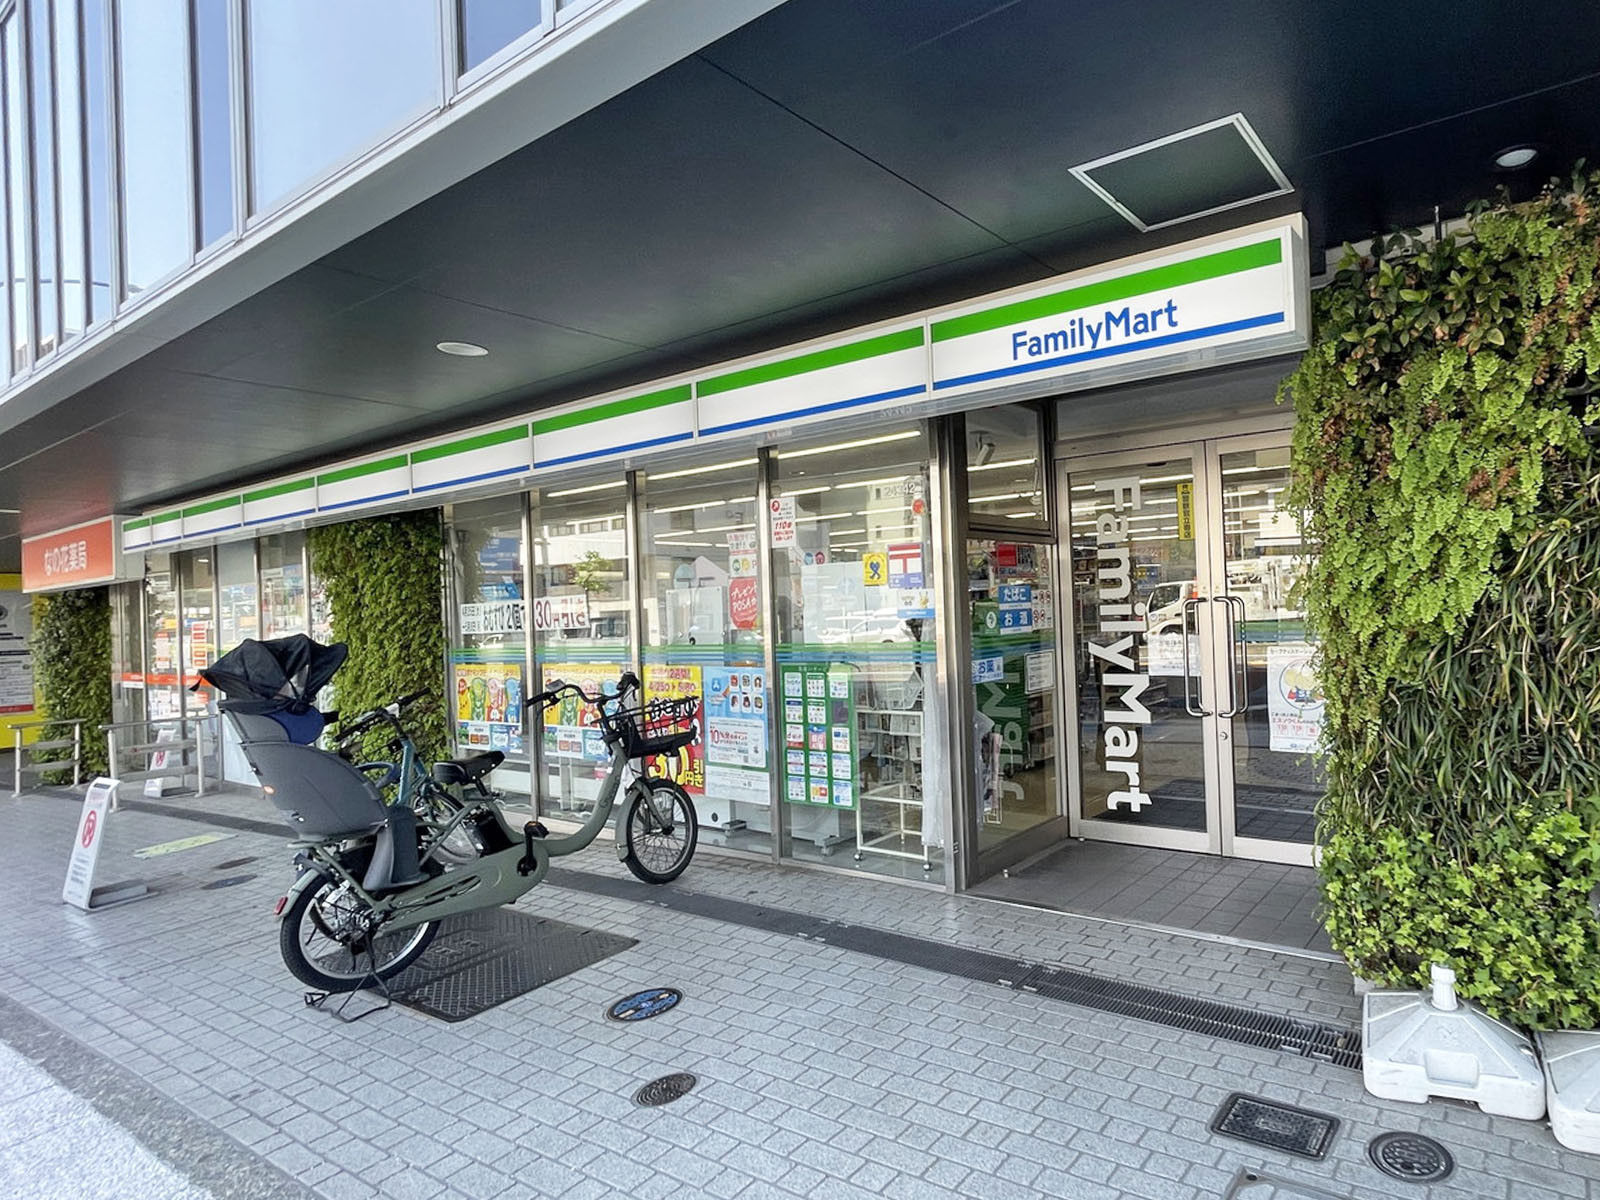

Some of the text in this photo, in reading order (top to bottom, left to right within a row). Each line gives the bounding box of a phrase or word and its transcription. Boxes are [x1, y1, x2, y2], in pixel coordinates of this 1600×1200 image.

[1012, 299, 1178, 361] FamilyMart
[44, 540, 87, 577] なの花薬局
[1003, 588, 1027, 602] たばこ
[1089, 476, 1153, 813] FamilyMart
